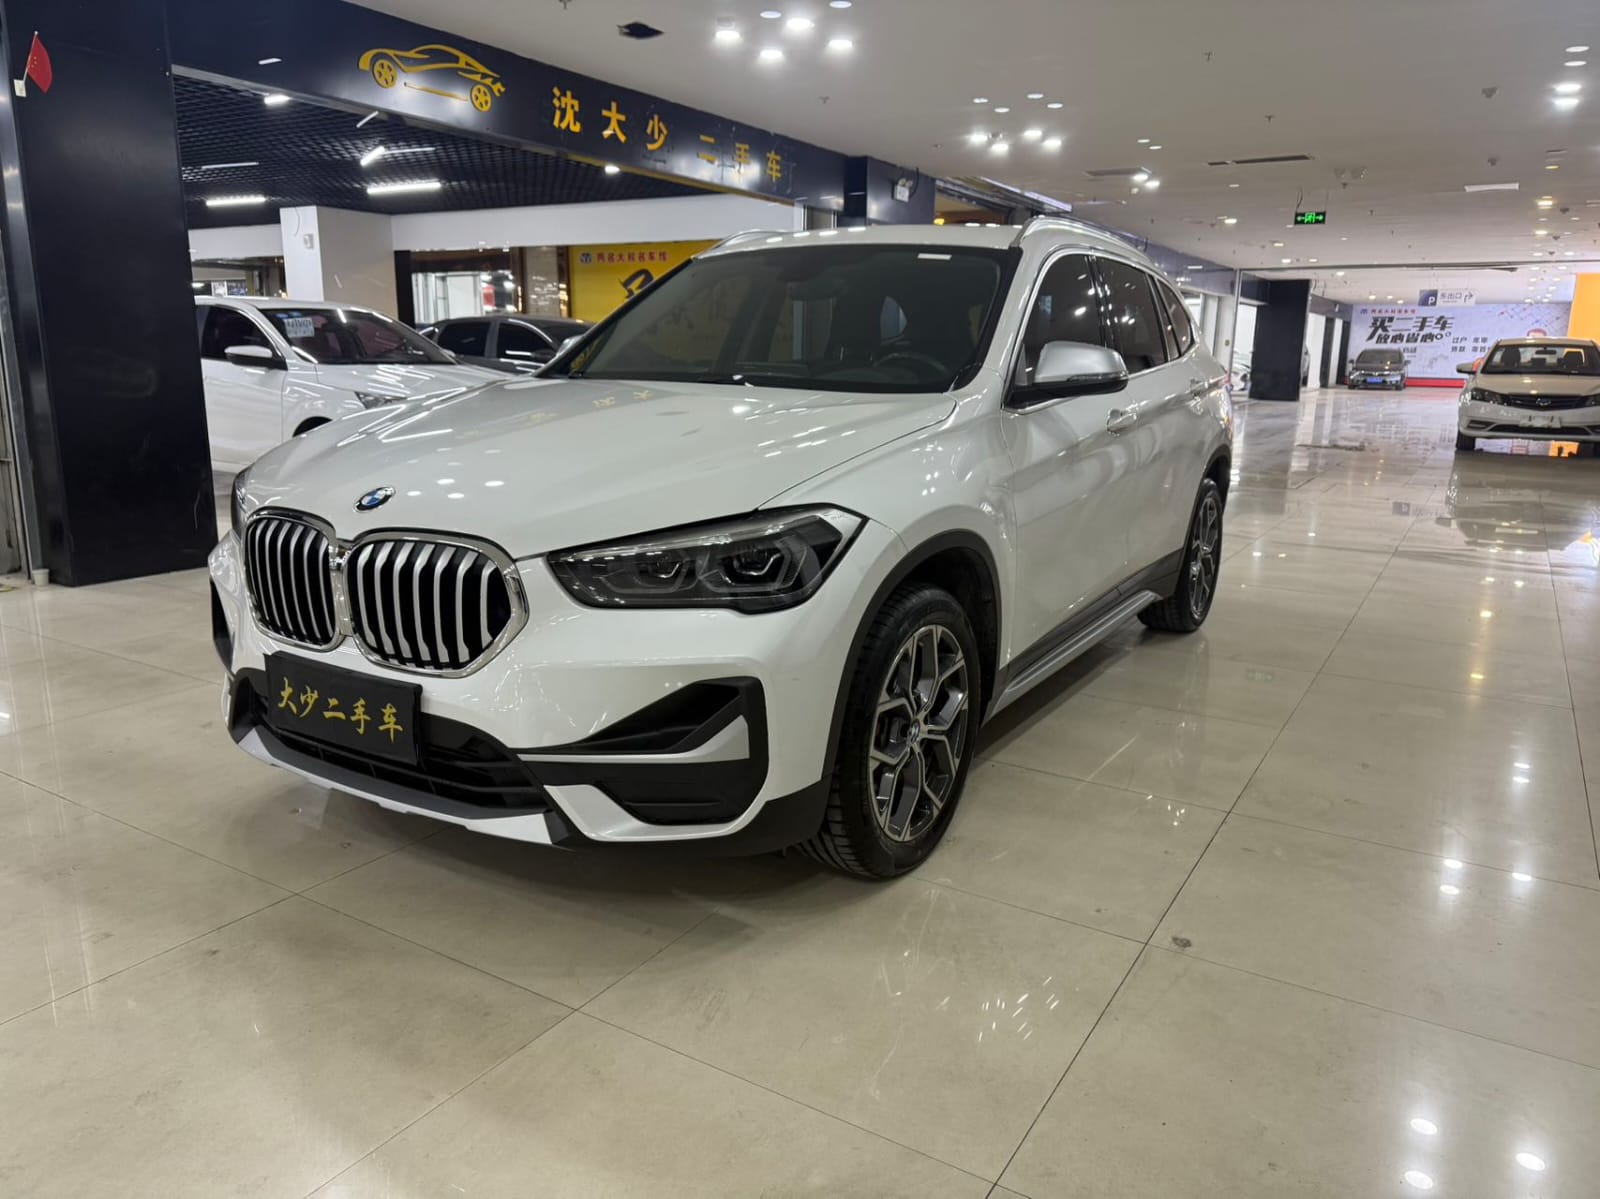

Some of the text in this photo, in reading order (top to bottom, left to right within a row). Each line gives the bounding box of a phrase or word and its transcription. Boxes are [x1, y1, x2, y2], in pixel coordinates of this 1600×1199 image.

[552, 86, 782, 182] 沈大少二手车
[1366, 315, 1455, 341] 买二手车
